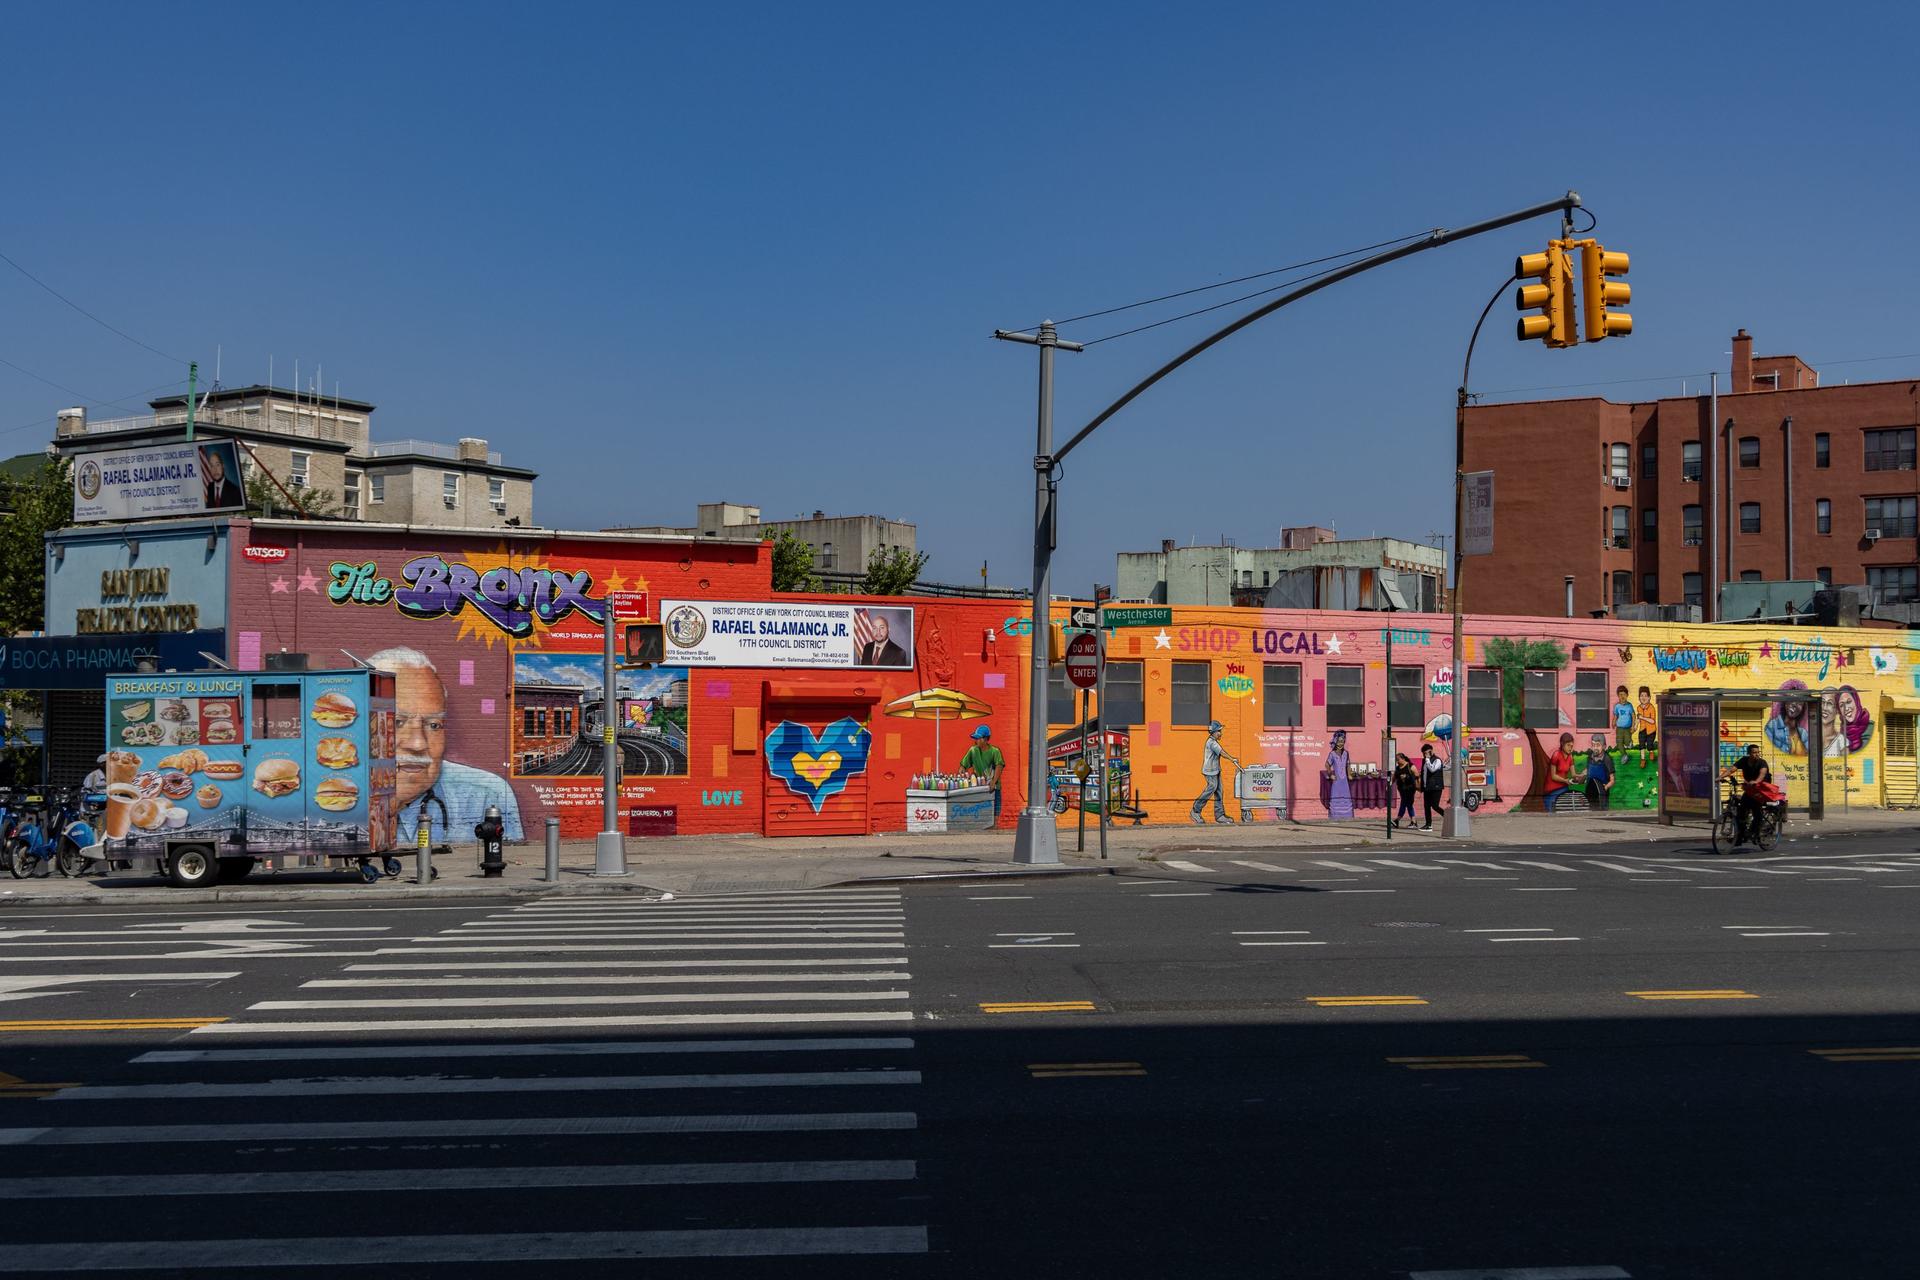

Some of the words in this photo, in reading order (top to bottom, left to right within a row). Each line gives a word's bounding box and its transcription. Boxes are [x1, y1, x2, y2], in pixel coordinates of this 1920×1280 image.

[103, 469, 132, 486] RAFAEL
[133, 465, 182, 483] SALAMANCA
[183, 463, 197, 479] JR.
[120, 490, 132, 499] 17TH
[132, 487, 156, 498] COUNCIL
[156, 485, 181, 496] DISTRICT
[101, 569, 129, 596] SAN
[128, 567, 170, 601] JUAN
[327, 561, 393, 604] The
[76, 607, 135, 634] HEALTH
[137, 604, 198, 632] CENTER
[712, 607, 736, 615] DISTRICT
[737, 607, 756, 616] OFFICE
[756, 608, 764, 616] OF
[765, 608, 776, 616] NEW
[777, 609, 792, 617] YORK
[793, 609, 805, 617] CITY
[805, 610, 827, 618] COUNCIL
[827, 610, 849, 618] MEMBER
[1077, 613, 1090, 622] ONE
[1107, 609, 1168, 619] Westchester
[712, 619, 756, 634] RAFAEL
[759, 620, 829, 636] SALAMANCA
[832, 622, 849, 637] JR.
[739, 639, 757, 648] 17TH
[758, 639, 792, 649] COUNCIL
[793, 639, 827, 649] DISTRICT
[1072, 644, 1083, 653] DO
[1085, 644, 1097, 653] NO
[1177, 628, 1240, 651] SHOP
[1252, 630, 1324, 655] LOCAL
[12, 650, 60, 669] BOCA
[66, 647, 154, 669] PHARMACY
[1778, 635, 1832, 682] Unity
[1073, 668, 1097, 678] ENTER
[115, 681, 184, 694] BREAKFAST
[185, 680, 197, 693] &
[200, 680, 243, 692] LUNCH
[1217, 676, 1254, 694] MATTER
[1664, 704, 1710, 717] INJURED?
[1060, 743, 1078, 751] HALAL
[702, 789, 743, 806] LOVE
[914, 808, 939, 820] $2.50
[489, 842, 500, 853] 12
